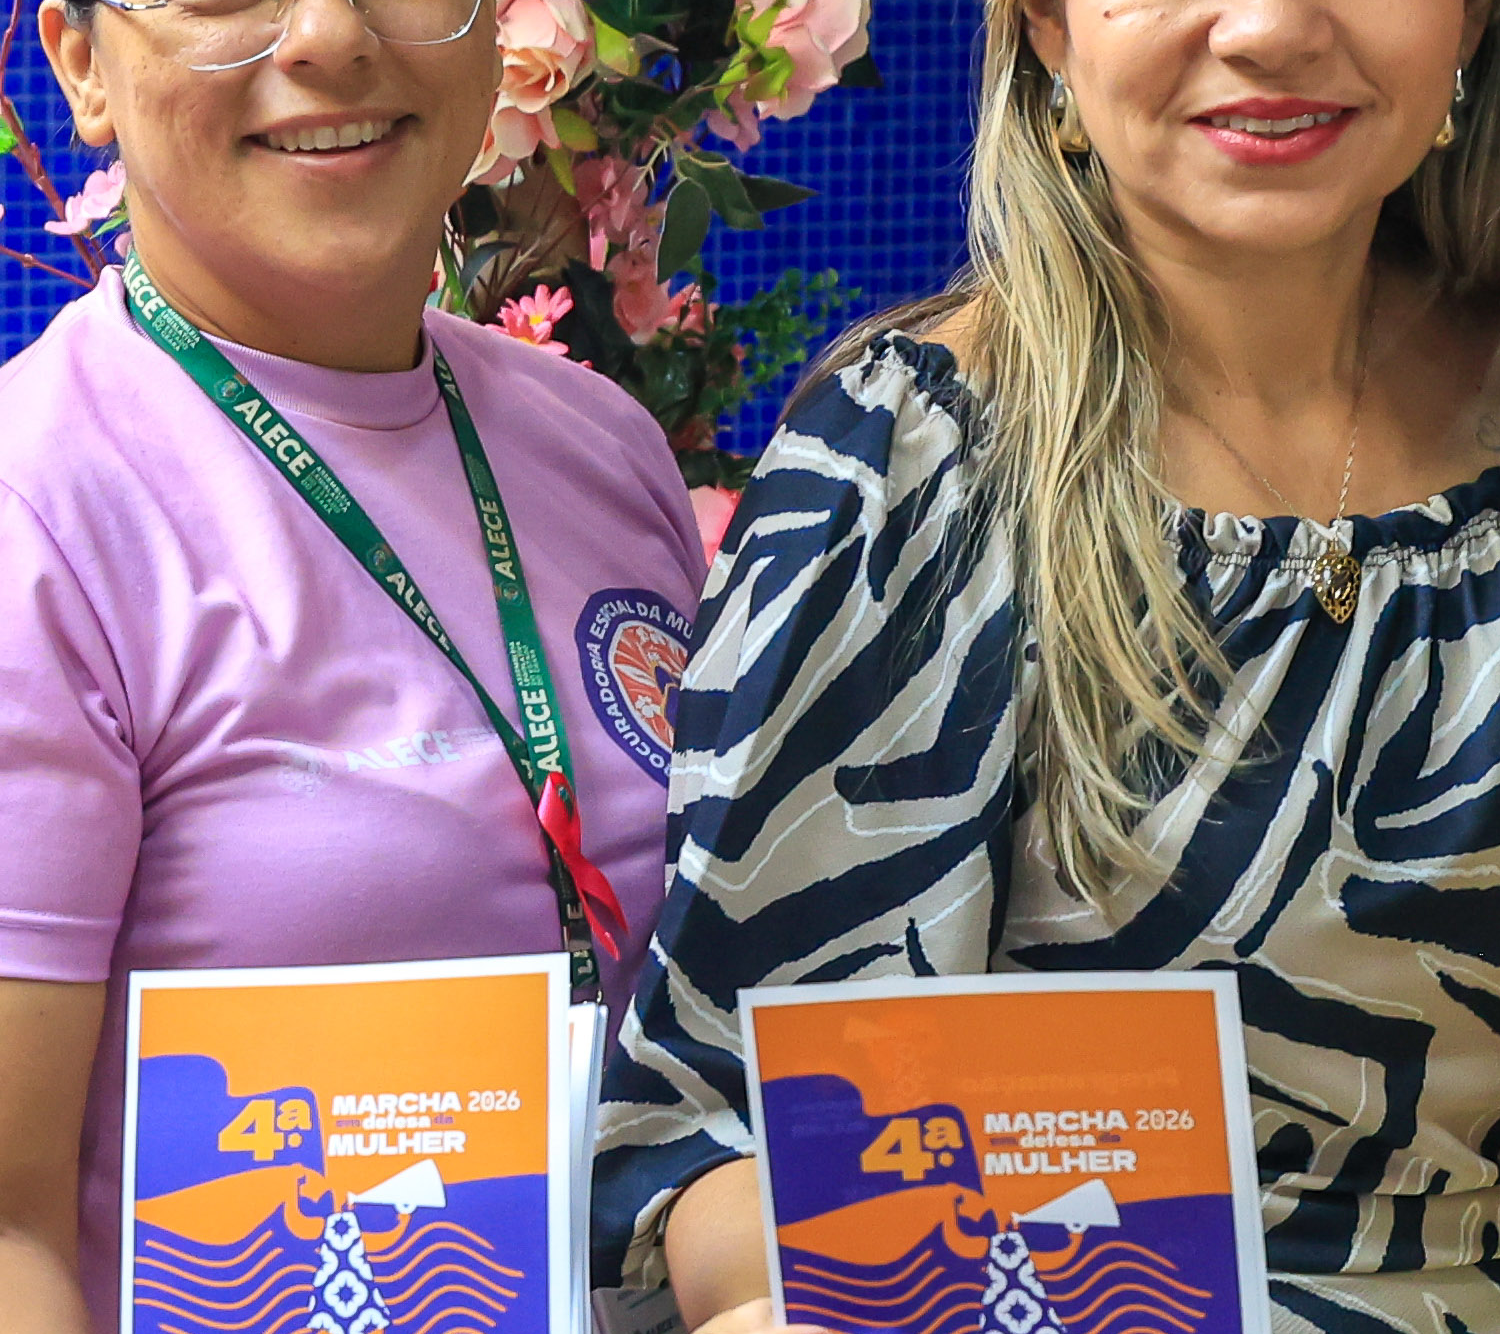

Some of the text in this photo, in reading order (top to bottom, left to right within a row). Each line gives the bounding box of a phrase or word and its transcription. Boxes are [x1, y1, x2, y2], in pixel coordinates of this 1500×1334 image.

[232, 398, 315, 479] ALECE
[479, 497, 516, 581] ALECE
[586, 640, 671, 777] OCURADORIA
[635, 601, 661, 622] DA
[521, 688, 563, 774] ALECE
[344, 729, 462, 773] ALECE
[331, 1089, 521, 1116] MARCHA 2026
[361, 1109, 432, 1131] defesa
[983, 1108, 1195, 1135] MARCHA 2026
[326, 1130, 467, 1157] MULHER
[983, 1149, 1138, 1176] MULHER
